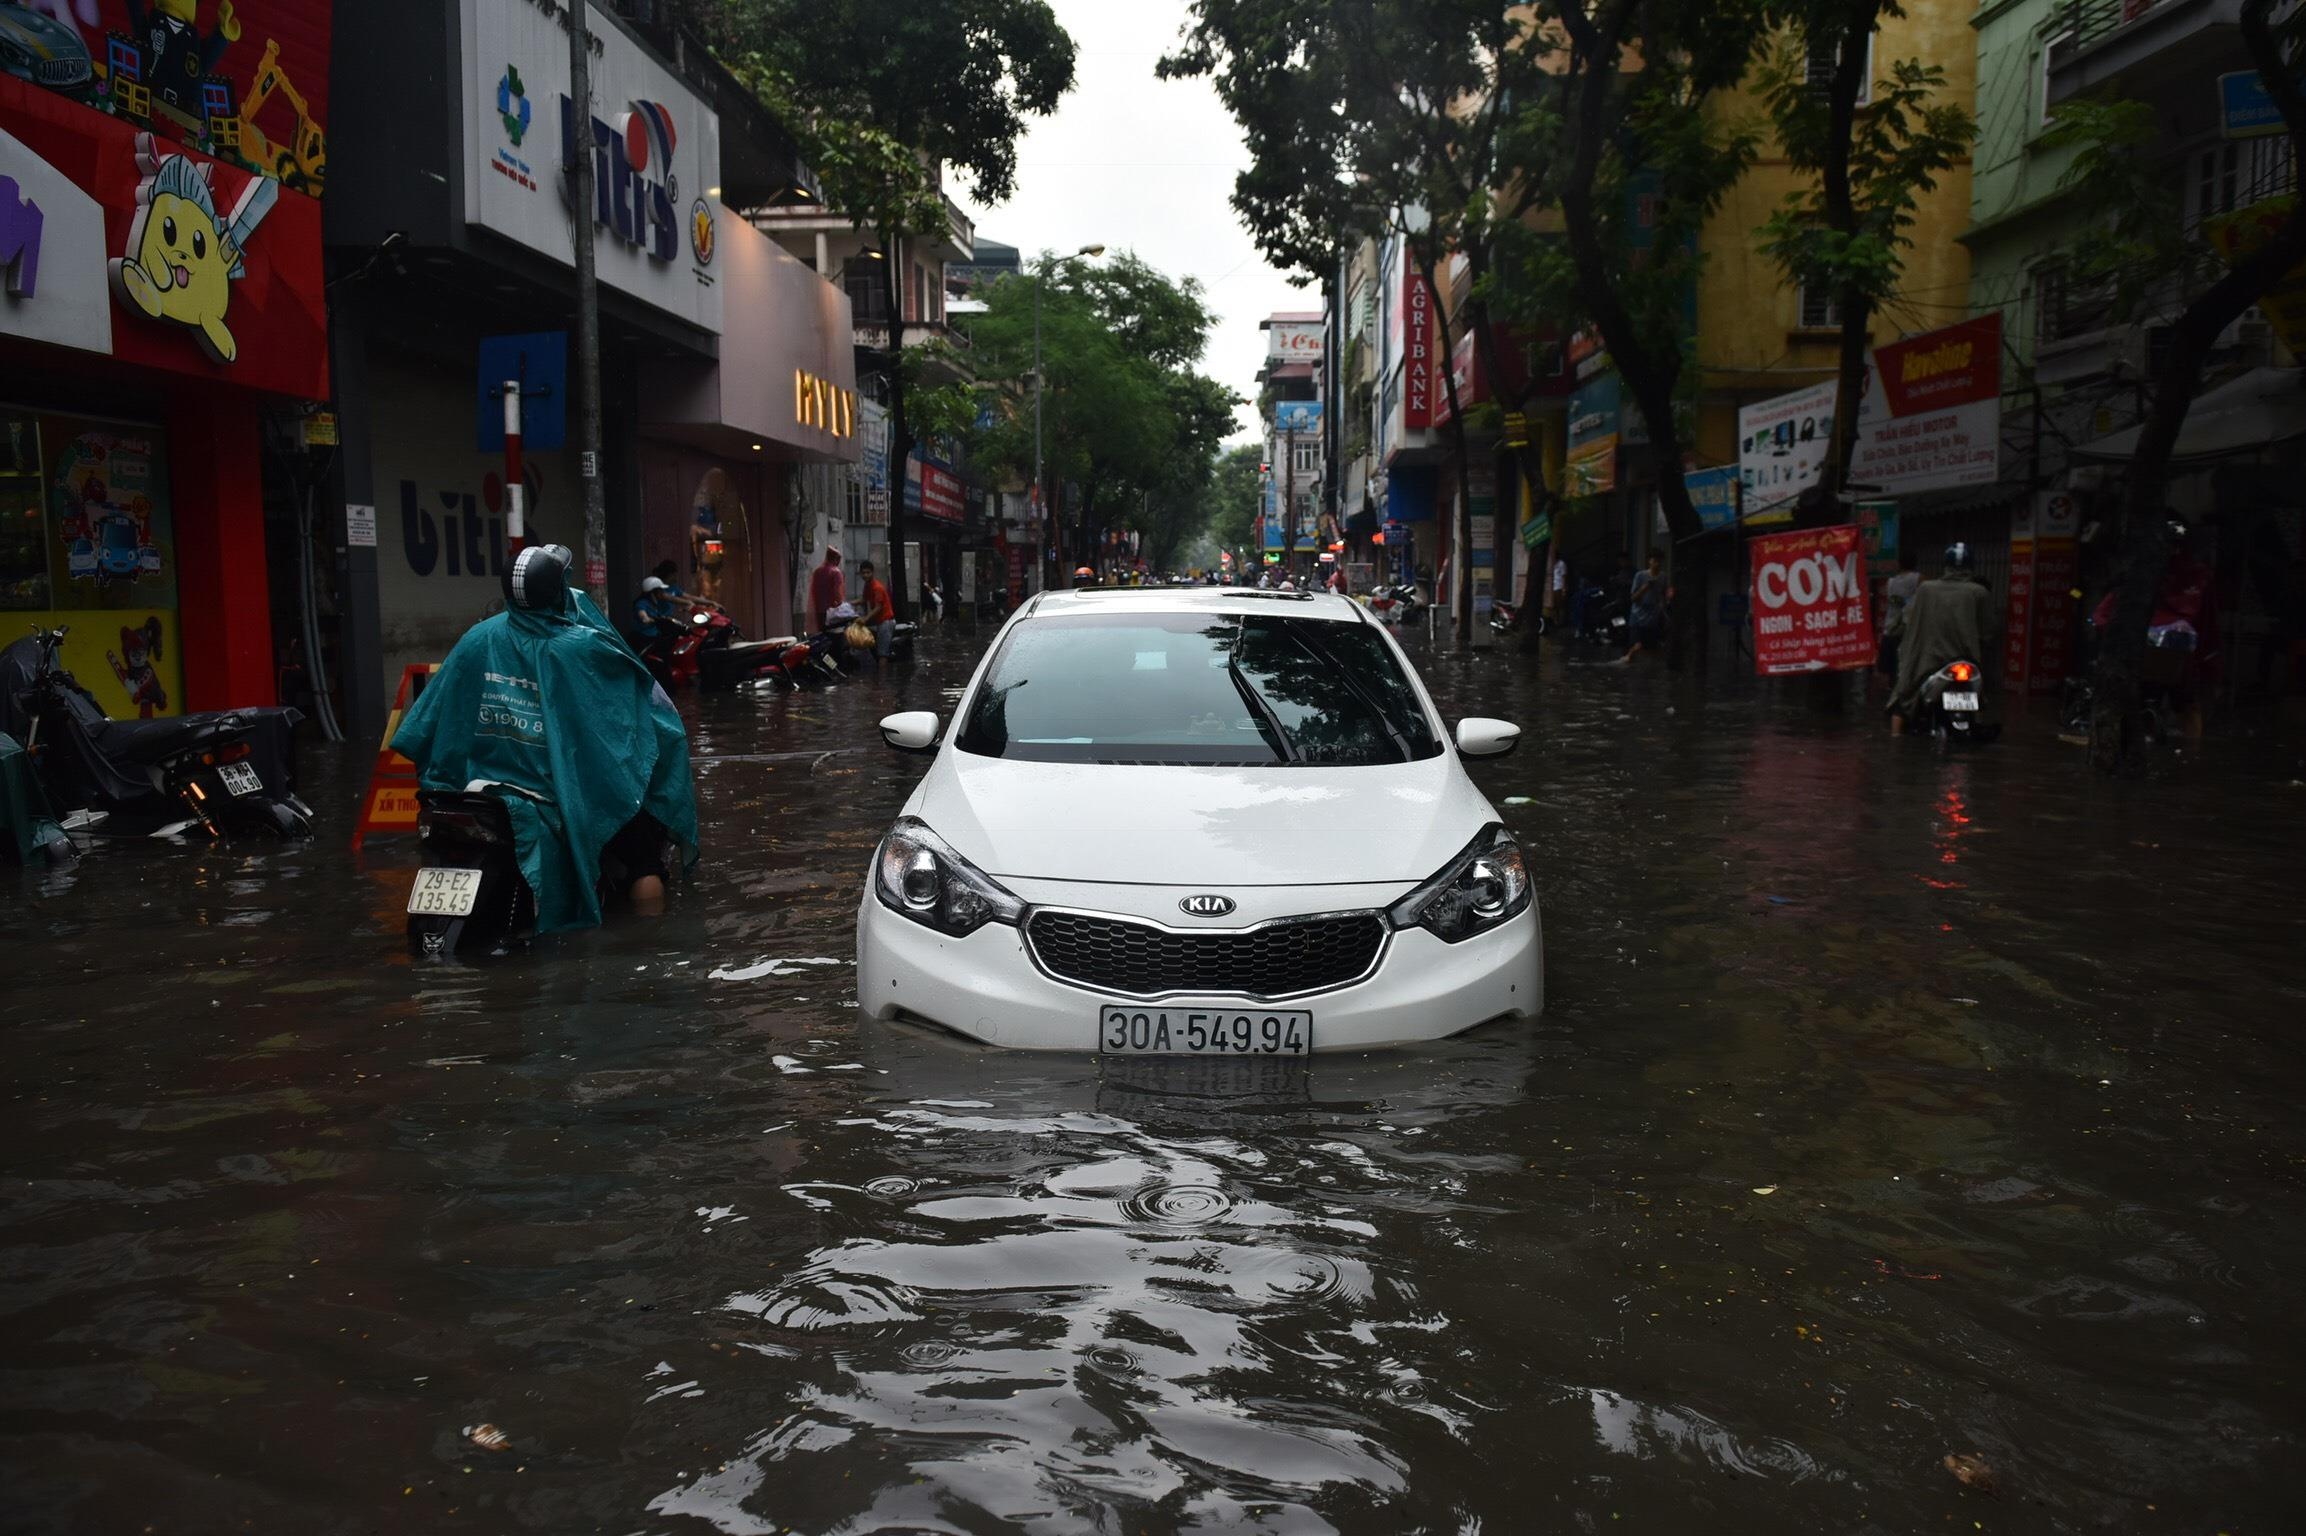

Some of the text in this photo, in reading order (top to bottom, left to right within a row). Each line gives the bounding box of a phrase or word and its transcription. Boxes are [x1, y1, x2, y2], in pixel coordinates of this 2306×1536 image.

[1411, 279, 1427, 411] AGRIBANK
[1757, 551, 1861, 608] CƠM
[1760, 614, 1793, 634] NGON
[1804, 609, 1838, 633] SẠCH
[494, 712, 528, 730] 1900
[229, 776, 261, 794] 004.90
[424, 871, 471, 890] 29-E2
[416, 892, 471, 912] 135.45
[1188, 897, 1228, 911] KIA
[1107, 1012, 1304, 1054] 30A-549.94
